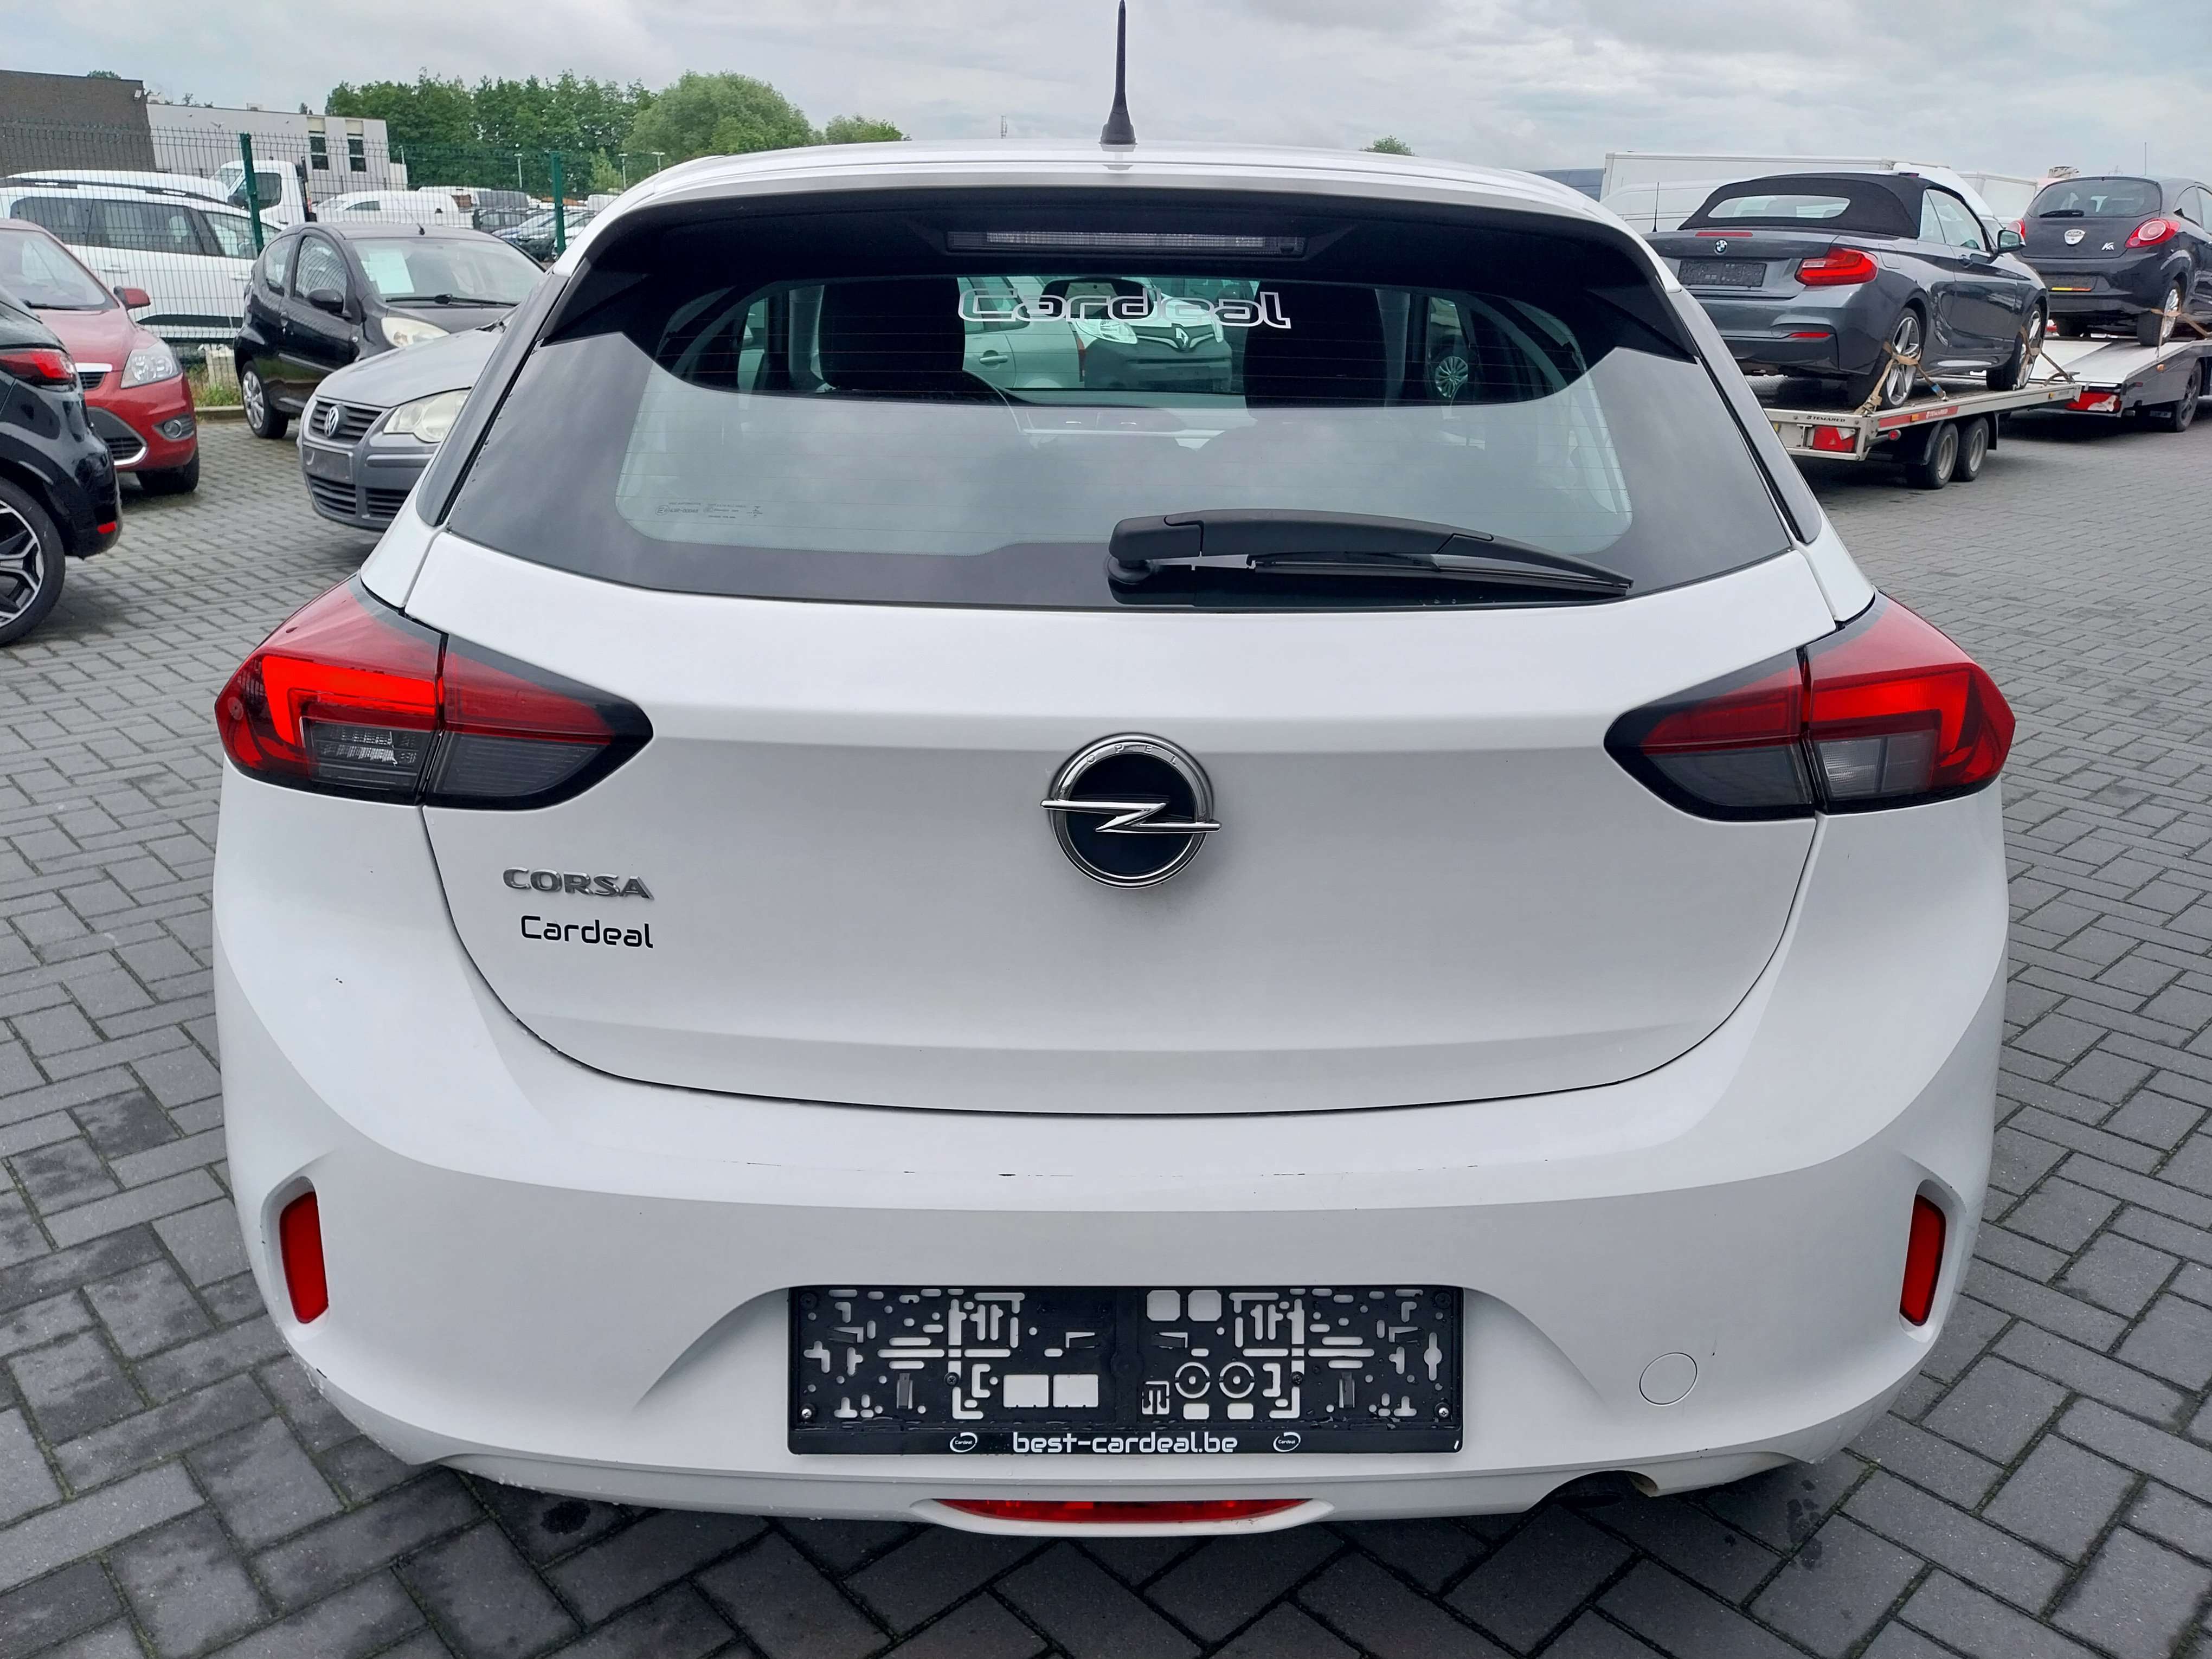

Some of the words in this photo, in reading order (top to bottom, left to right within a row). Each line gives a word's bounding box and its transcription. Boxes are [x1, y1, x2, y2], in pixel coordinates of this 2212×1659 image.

[958, 287, 1291, 329] Cardeal
[1086, 744, 1178, 766] OPEL
[503, 866, 654, 901] CORSA
[521, 915, 654, 949] Cardeal
[1013, 1431, 1238, 1454] best-cardeal.be
